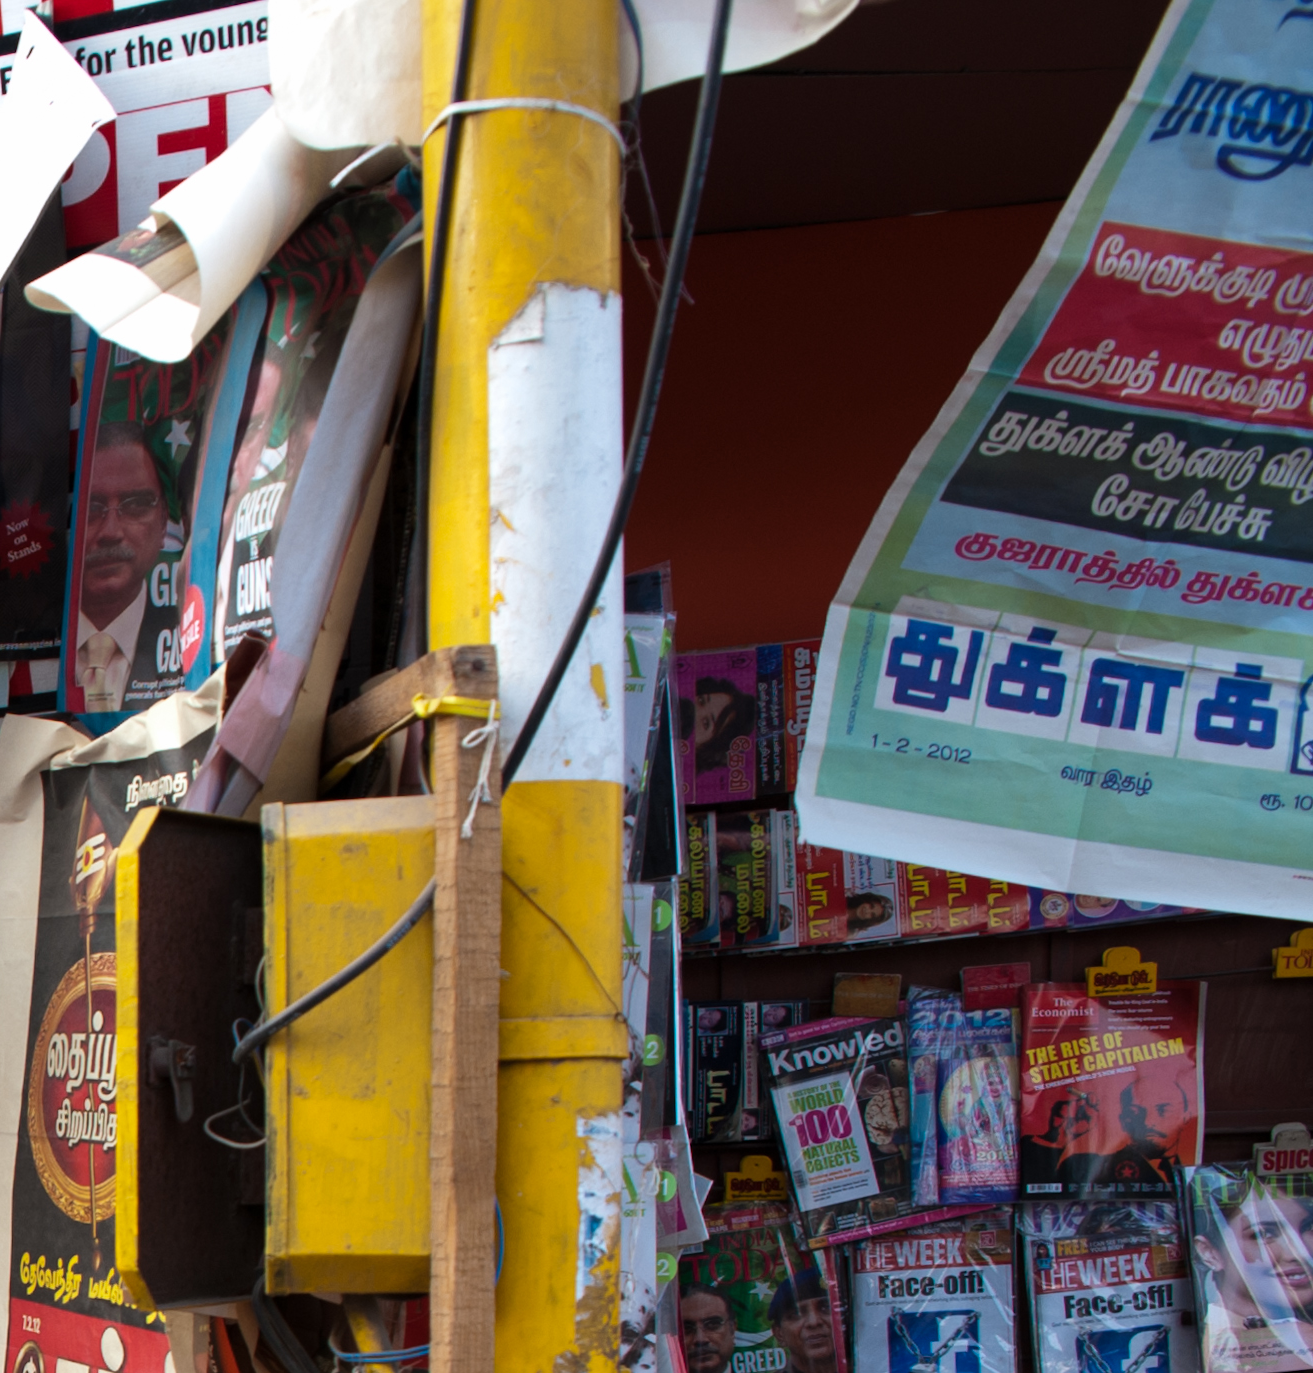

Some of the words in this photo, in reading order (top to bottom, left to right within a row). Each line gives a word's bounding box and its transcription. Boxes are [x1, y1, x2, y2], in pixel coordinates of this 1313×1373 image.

[124, 35, 174, 68] the
[1094, 234, 1280, 308] வேளுக்குடி
[1160, 360, 1308, 418] பாகவதம்
[979, 404, 1129, 490] துக்ளக்
[1132, 426, 1258, 493] ஆண்டு
[1091, 474, 1171, 527] சோ
[1173, 485, 1273, 541] பேச்சு
[953, 528, 1181, 593] குஜராத்தில்
[884, 617, 1280, 752] துக்ளக்
[912, 1006, 1011, 1028] 2012
[1031, 1006, 1095, 1018] Economist
[1025, 1044, 1058, 1067] THE
[1060, 1035, 1102, 1060] RISE
[1028, 1059, 1081, 1084] STATE
[1082, 1037, 1186, 1073] CAPITALISM
[789, 1087, 845, 1115] WORLD
[892, 1235, 965, 1267] WEEK
[878, 1270, 985, 1299] Face-off!
